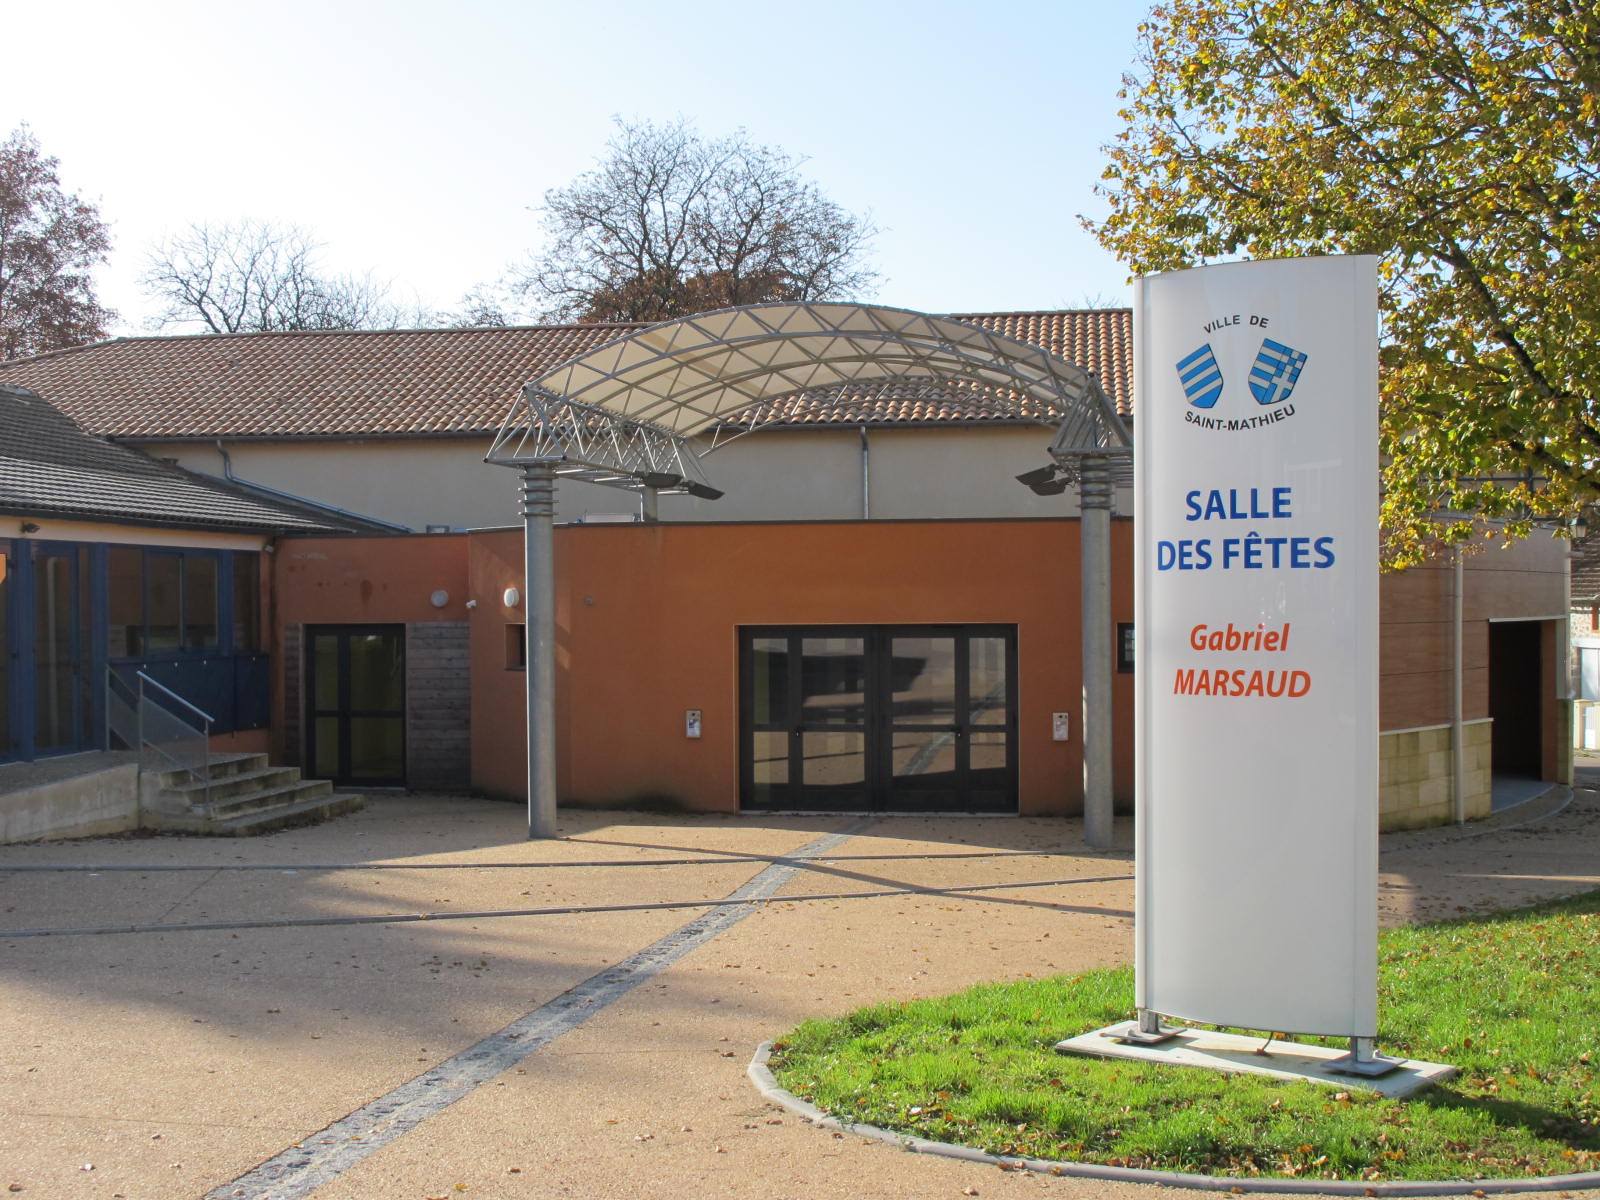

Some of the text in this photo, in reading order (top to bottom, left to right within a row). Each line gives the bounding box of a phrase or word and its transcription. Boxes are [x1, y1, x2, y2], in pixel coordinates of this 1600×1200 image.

[1203, 314, 1269, 334] VILLE DE
[1184, 403, 1296, 431] SAINT-MATHIEU
[1185, 487, 1292, 521] SALLE
[1157, 531, 1336, 571] DES FÊTES
[1190, 623, 1290, 652] Gabriel
[1173, 668, 1312, 698] MARSAUD
